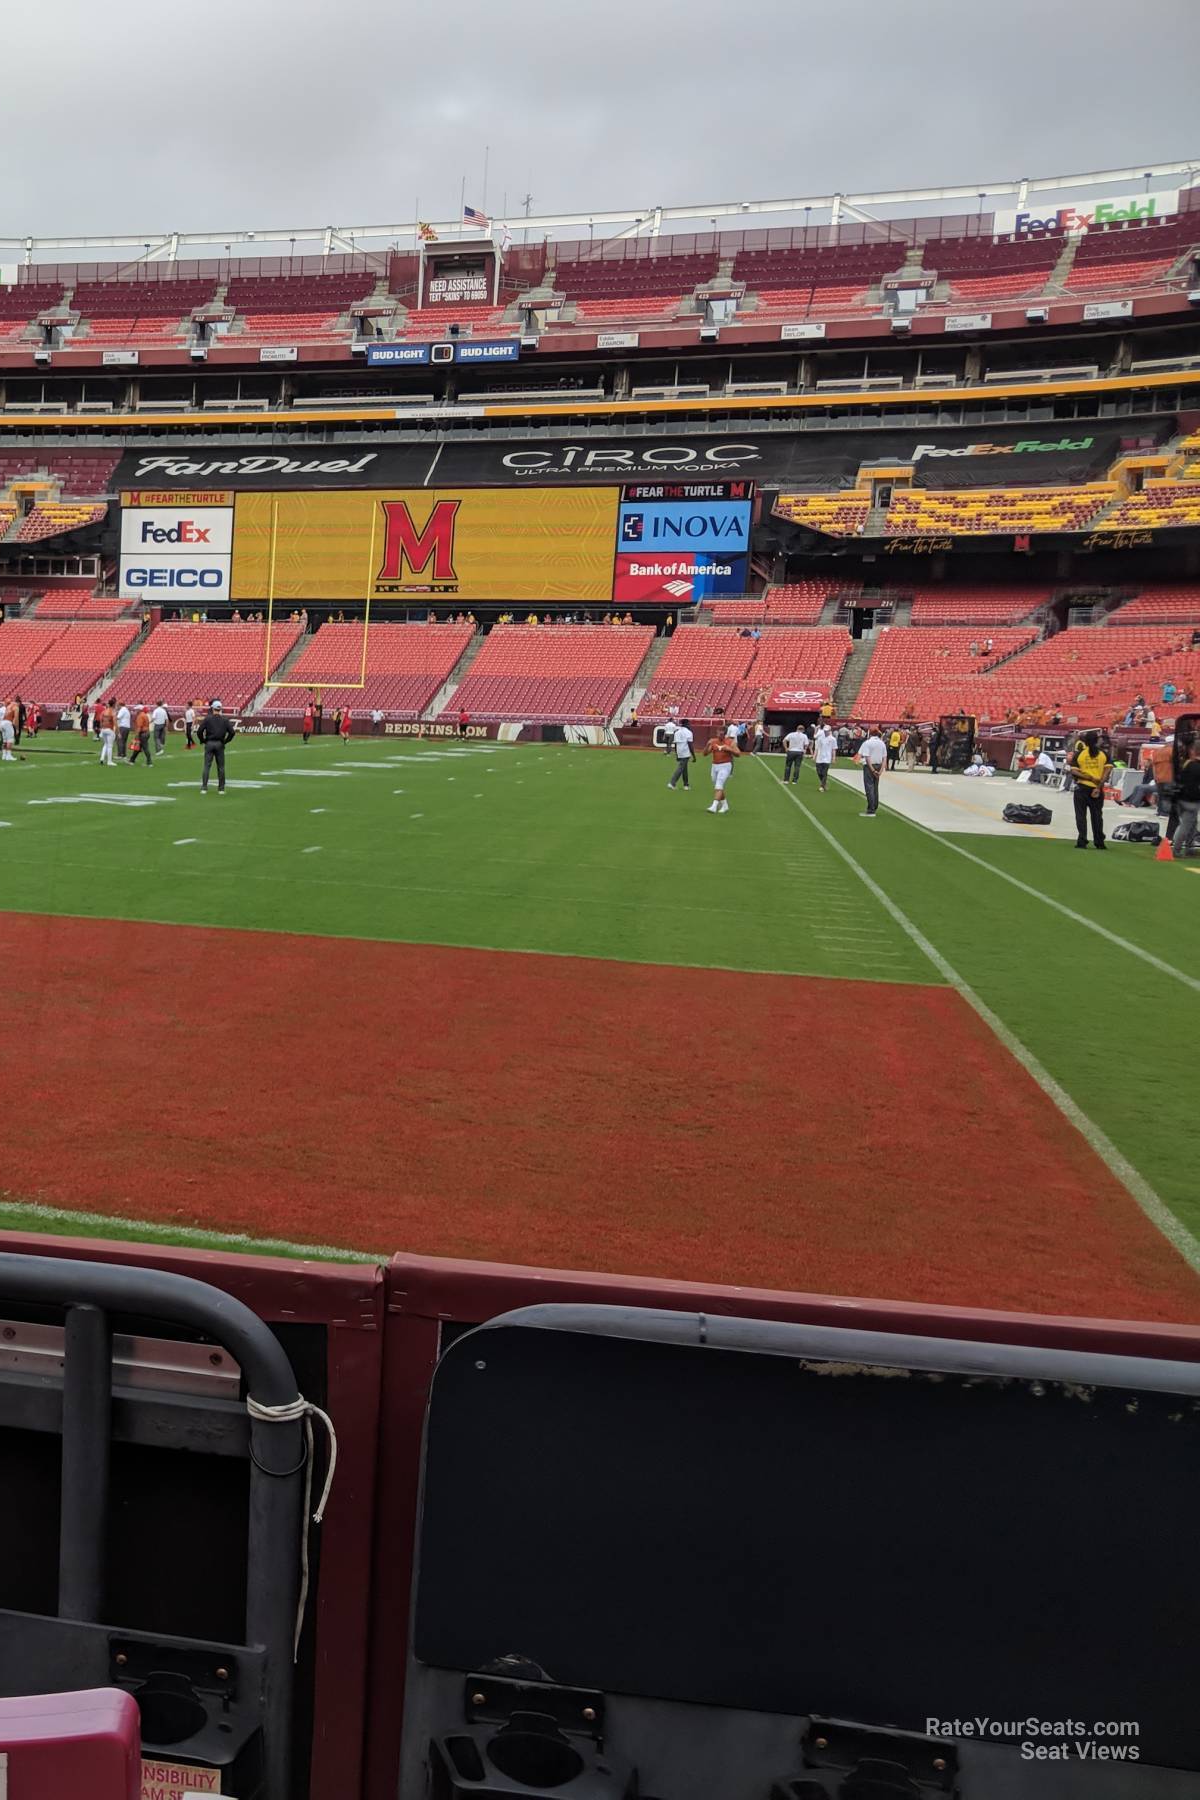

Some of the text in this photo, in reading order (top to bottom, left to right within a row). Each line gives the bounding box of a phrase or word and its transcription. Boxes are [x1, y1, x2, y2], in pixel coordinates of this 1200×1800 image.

[1015, 198, 1156, 234] FedExField
[430, 278, 487, 292] NEED ASSISTANCE
[429, 293, 442, 302] TEXT
[463, 292, 470, 300] TO
[372, 349, 425, 360] BUD LIGHT
[460, 346, 514, 357] BUD LIGHT
[912, 437, 1094, 461] FedExField
[135, 453, 377, 476] FanDuel
[515, 462, 741, 476] ULTRA PREMIUM VODKA
[145, 493, 225, 504] #FEARTHETURTLE
[629, 485, 724, 498] #FEARTHETURTLE
[141, 521, 211, 543] FedEx
[652, 516, 744, 537] INOVA
[376, 500, 462, 580] M
[630, 562, 732, 576] Bank of America
[126, 568, 223, 588] GEICO
[230, 718, 287, 734] Foundation
[143, 1766, 217, 1790] NSIBILITY
